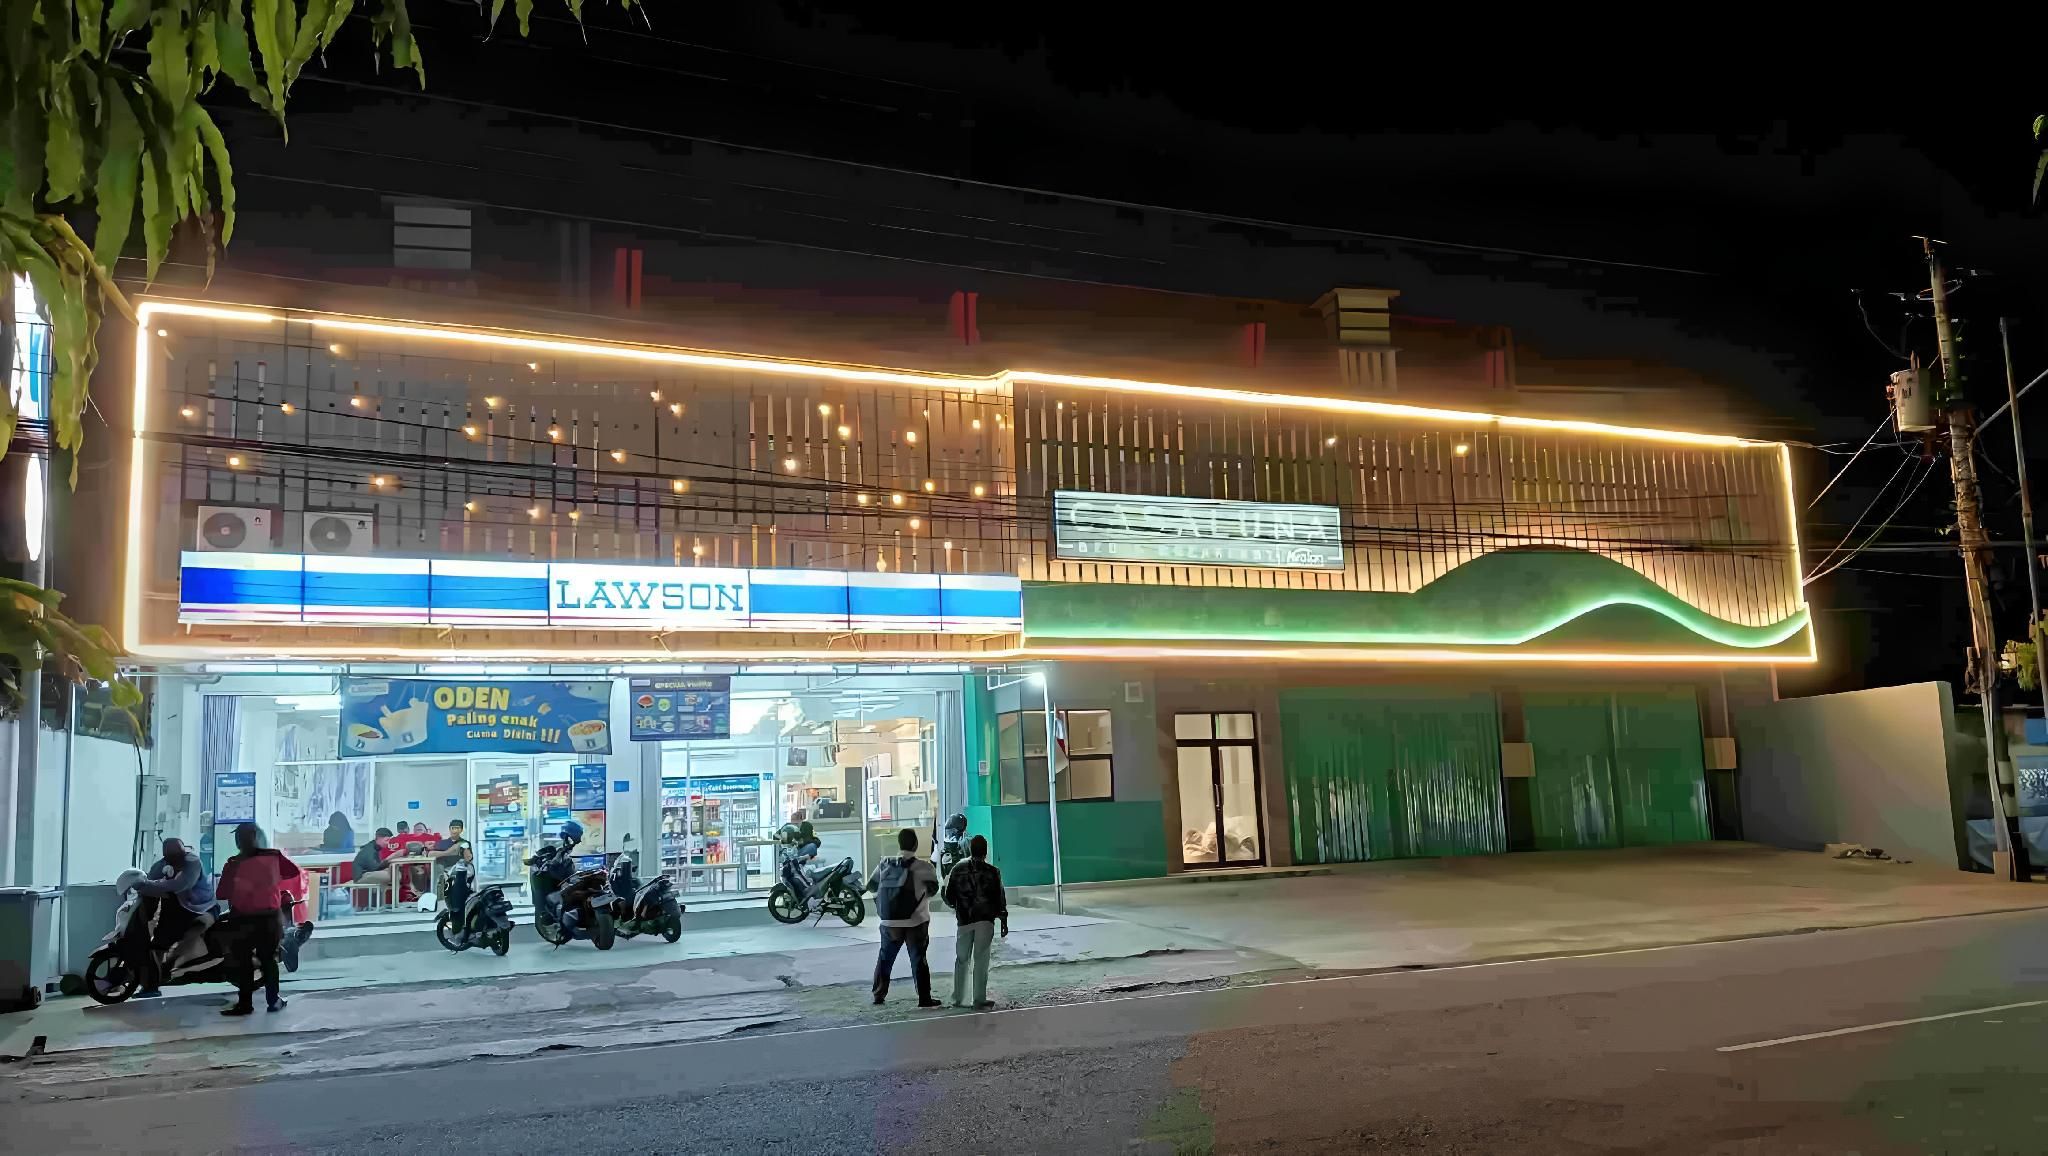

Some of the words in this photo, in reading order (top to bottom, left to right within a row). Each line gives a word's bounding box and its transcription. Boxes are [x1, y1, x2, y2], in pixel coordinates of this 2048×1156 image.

[556, 580, 744, 611] LAWSON
[434, 687, 510, 710] ODEN
[501, 714, 538, 728] enak
